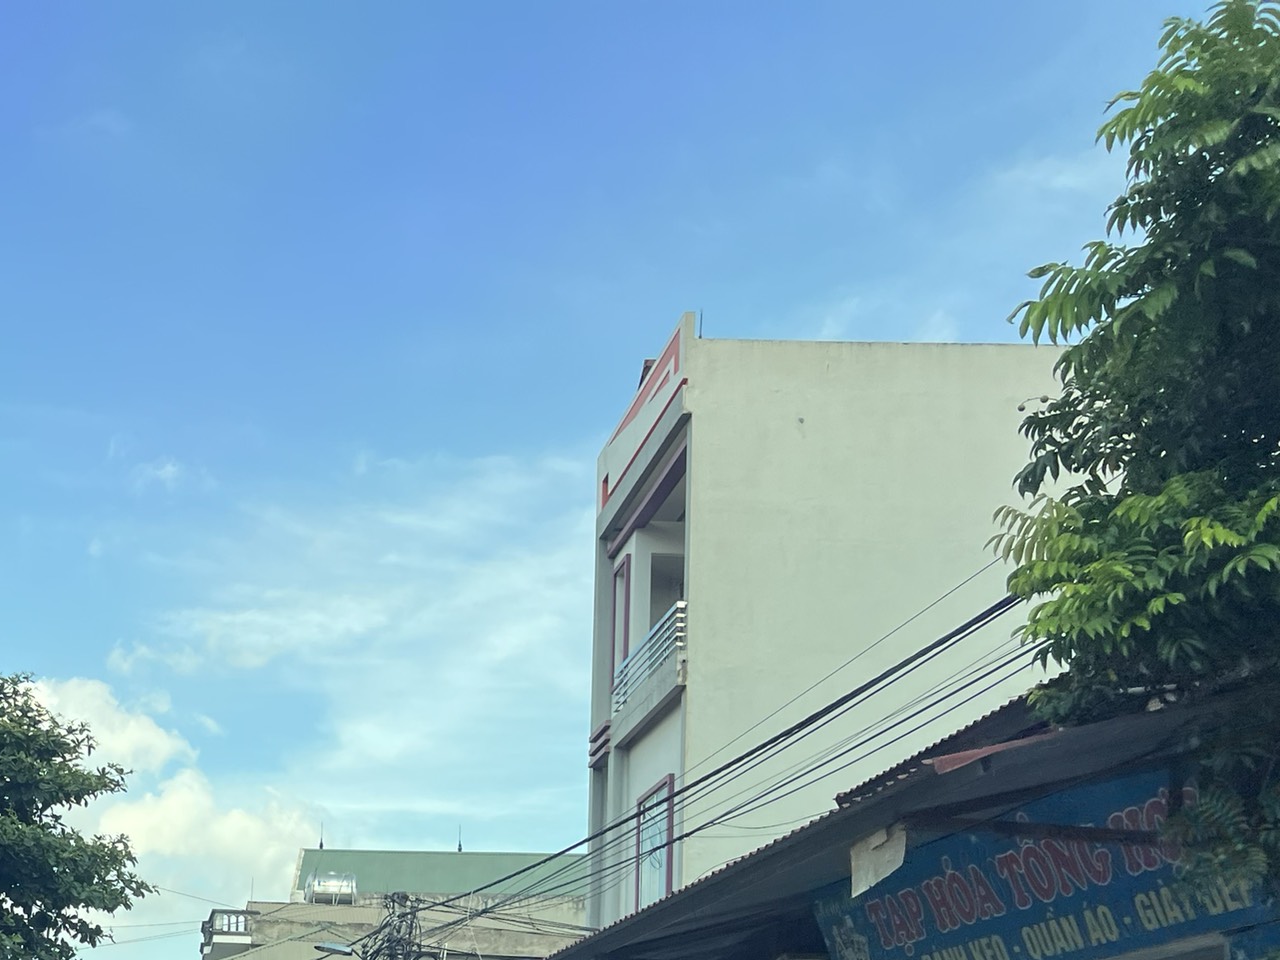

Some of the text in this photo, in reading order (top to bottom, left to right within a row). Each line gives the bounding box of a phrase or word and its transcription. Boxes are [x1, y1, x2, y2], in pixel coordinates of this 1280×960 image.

[866, 888, 927, 957] TẠP
[1021, 906, 1085, 960] QUẦN
[1084, 901, 1121, 947] ÁO
